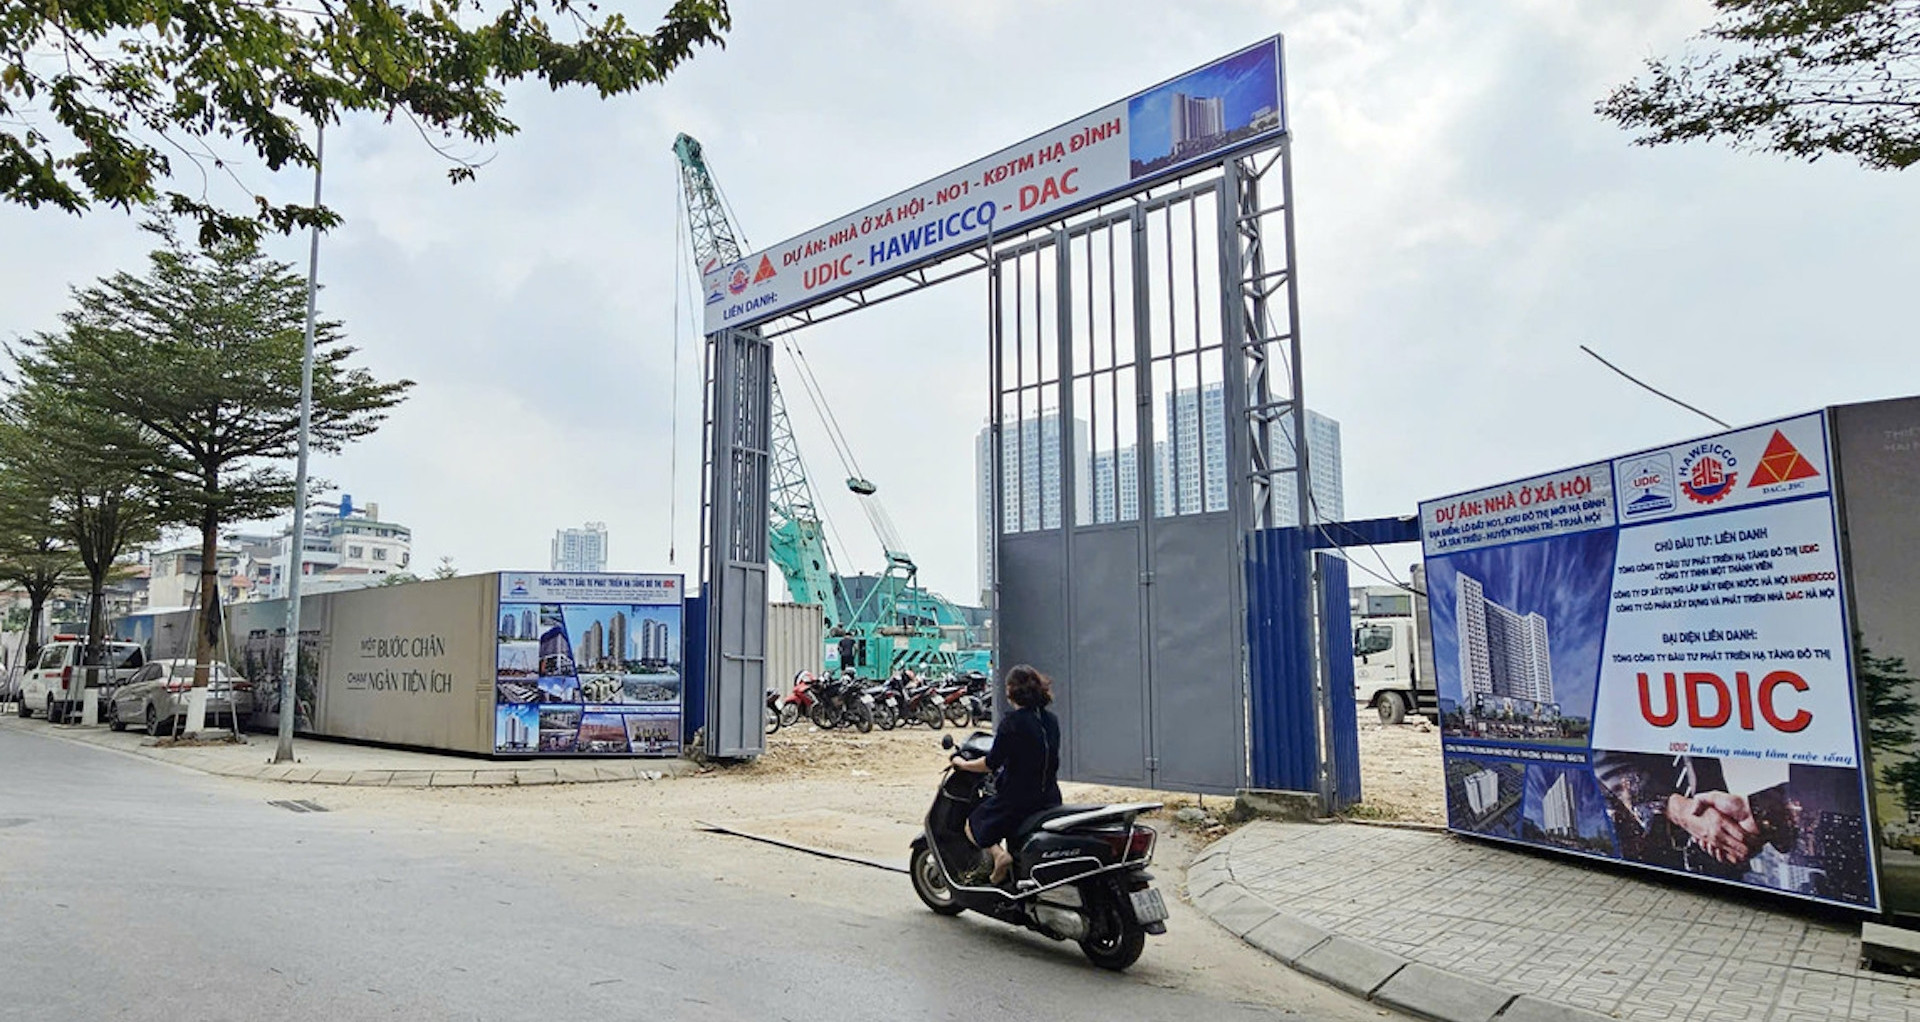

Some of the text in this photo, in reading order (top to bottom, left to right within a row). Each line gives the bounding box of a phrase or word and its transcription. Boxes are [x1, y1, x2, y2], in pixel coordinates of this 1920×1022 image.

[783, 247, 802, 266] DỰ
[804, 240, 827, 259] ÁN:
[829, 226, 858, 248] NHÀ
[861, 216, 873, 235] Ở
[875, 208, 894, 230] XÃ
[897, 198, 924, 221] HỘI
[983, 153, 1034, 187] KĐTM
[1038, 141, 1065, 165] HẠ
[1069, 117, 1120, 153] ĐÌNH
[804, 254, 853, 290] UDIC
[869, 200, 996, 267] HAWEICCO
[1018, 167, 1079, 212] DAC
[723, 293, 778, 321] LIÊN DANH:
[1679, 443, 1738, 477] HAWEICCO
[1633, 474, 1661, 487] UDIC
[1436, 475, 1592, 526] DỰ ÁN: NHÀ Ở XÃ HỘI
[1654, 527, 1768, 552] CHỦ ĐẦU TƯ: LIÊN DANH
[1636, 563, 1655, 572] CÔNG
[1656, 562, 1664, 570] TY
[1692, 555, 1710, 566] PHÁT
[1735, 552, 1746, 562] HẠ
[1770, 546, 1782, 557] ĐÔ
[1784, 546, 1798, 557] THỊ
[1799, 543, 1820, 554] UDIC
[1660, 571, 1678, 580] CÔNG
[1680, 570, 1689, 579] TY
[1710, 566, 1727, 576] MỘT
[1755, 560, 1773, 571] VIÊN
[1613, 590, 1631, 599] CÔNG
[1632, 589, 1640, 597] TY
[1761, 575, 1772, 586] HÀ
[1774, 575, 1788, 586] NỘI
[1790, 571, 1836, 584] HAWEICCO
[1616, 603, 1633, 613] CÔNG
[1635, 603, 1642, 611] TY
[1785, 590, 1804, 601] DAC
[1806, 587, 1817, 599] HÀ
[1819, 587, 1835, 599] NỘI
[377, 635, 409, 658] BƯỚC
[412, 634, 445, 658] CHÂN
[1662, 628, 1758, 646] ĐẠI DIỆN LIÊN DANH:
[1633, 652, 1655, 662] CÔNG
[1656, 653, 1666, 661] TY
[1668, 652, 1685, 661] ĐẦU
[1686, 652, 1698, 661] TƯ
[1700, 650, 1722, 660] PHÁT
[1752, 650, 1766, 661] HẠ
[1767, 648, 1795, 660] TẦNG
[1796, 647, 1812, 659] ĐÔ
[1814, 648, 1831, 661] THỊ
[368, 668, 399, 691] NGÀN
[401, 669, 427, 695] TIỆN
[430, 668, 452, 693] ÍCH
[1636, 670, 1813, 733] UDIC
[1669, 742, 1688, 752] UDIC
